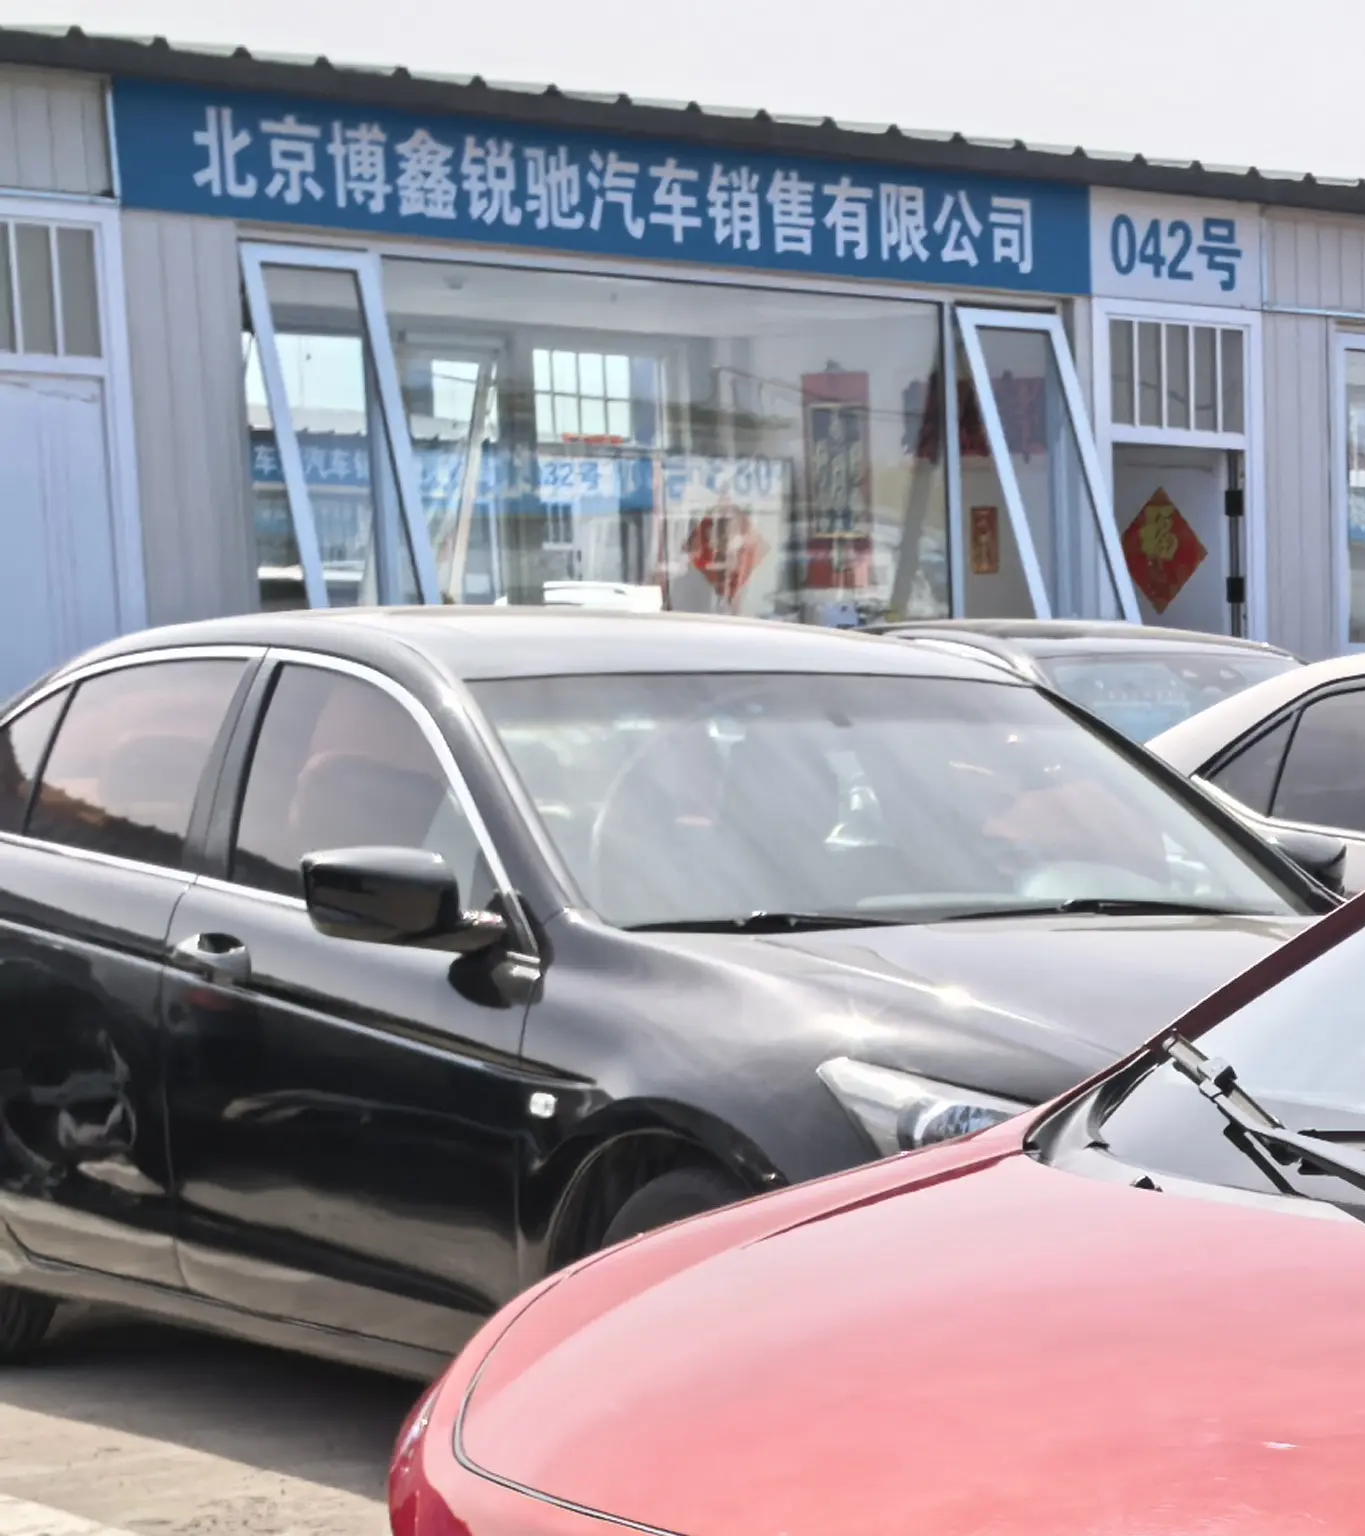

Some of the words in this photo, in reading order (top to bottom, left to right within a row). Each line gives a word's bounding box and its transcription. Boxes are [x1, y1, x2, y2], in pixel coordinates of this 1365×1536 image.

[193, 104, 1034, 275] 北京博鑫锐驰汽车销售有限公司
[1110, 213, 1242, 292] 042号
